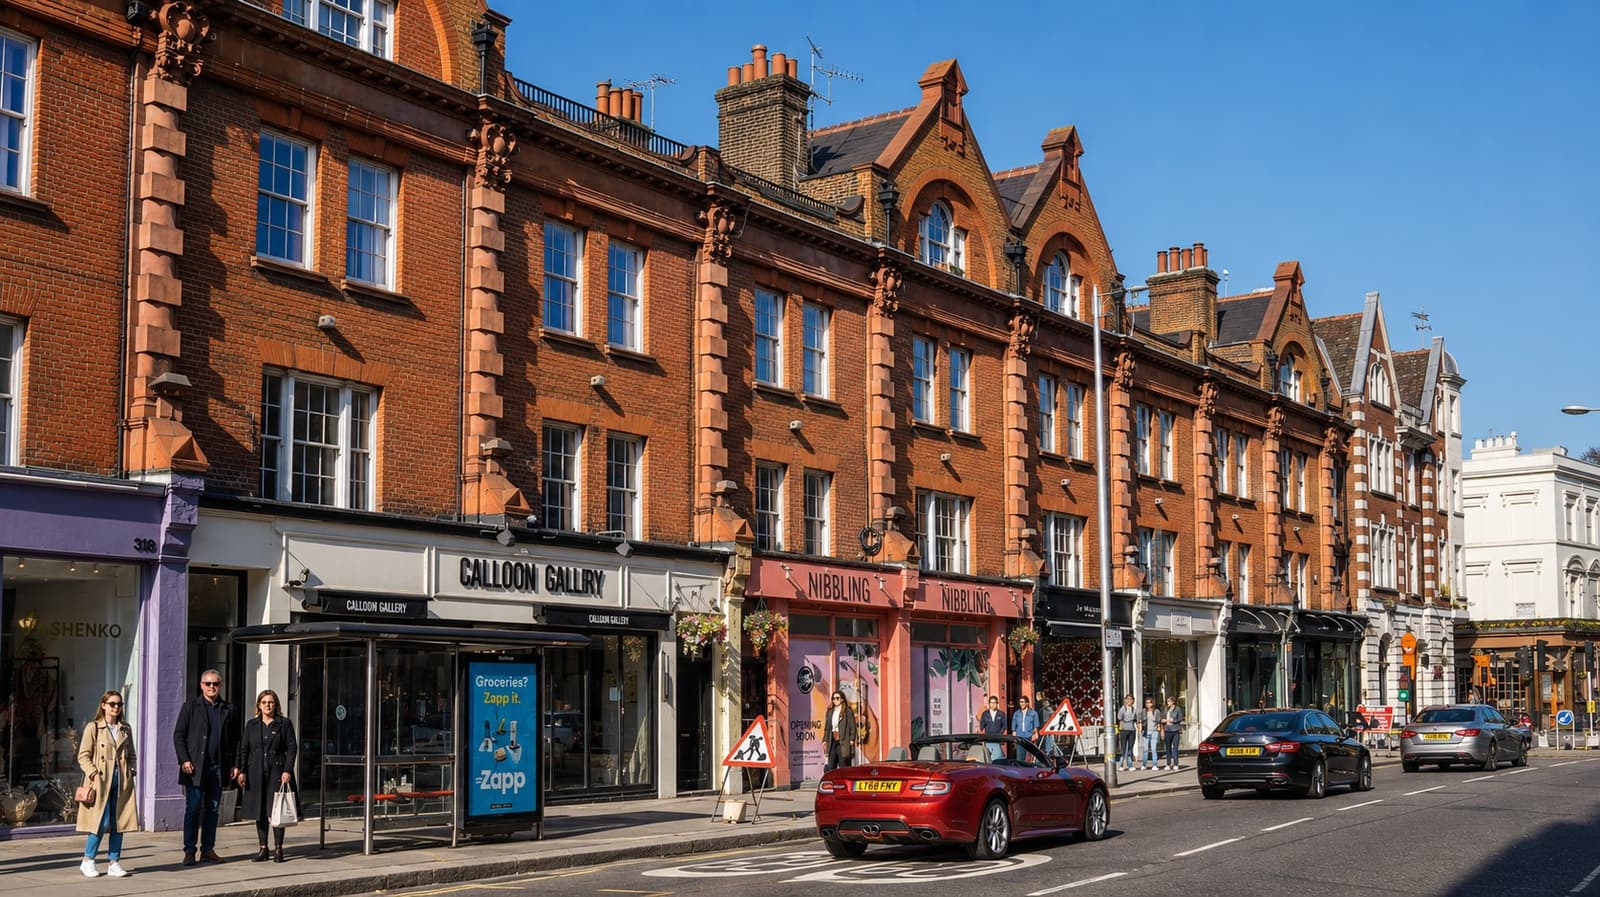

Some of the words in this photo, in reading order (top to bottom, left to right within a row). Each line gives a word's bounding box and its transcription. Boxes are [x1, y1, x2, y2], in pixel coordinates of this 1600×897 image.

[459, 557, 537, 591] CALLOON
[808, 571, 871, 603] NIBBLING
[346, 599, 378, 612] CALLOON
[379, 602, 408, 614] GALLERY
[941, 586, 991, 614] NIBBLING
[51, 621, 122, 638] SHENKO
[475, 675, 529, 688] Groceries?
[483, 691, 510, 707] Zapp
[511, 691, 521, 704] it.
[791, 719, 822, 730] OPENING
[795, 731, 816, 742] SOON
[479, 769, 527, 795] Zapp
